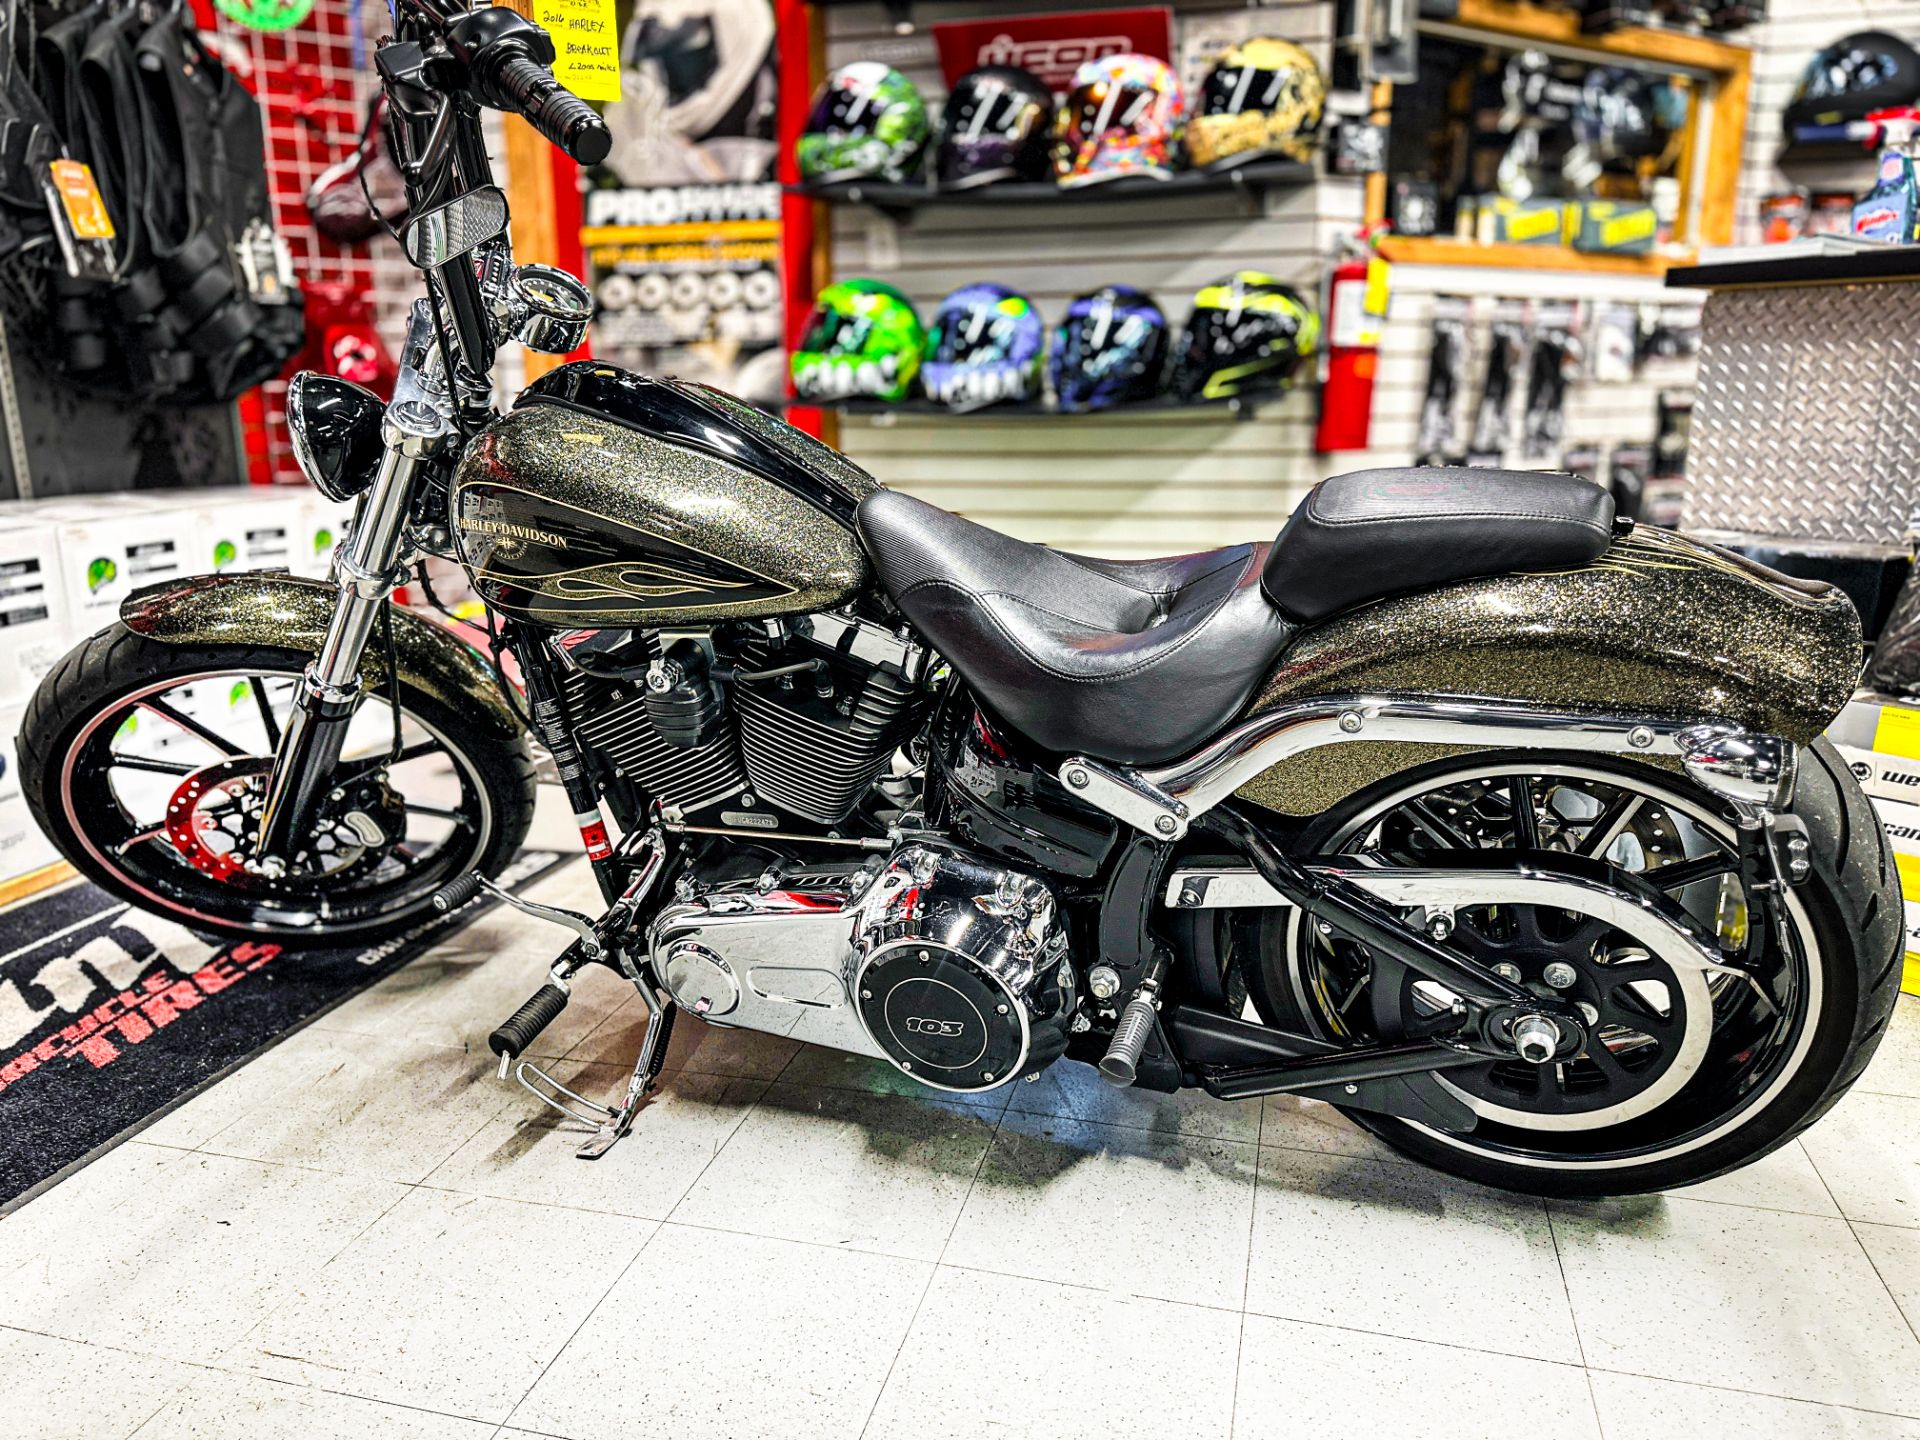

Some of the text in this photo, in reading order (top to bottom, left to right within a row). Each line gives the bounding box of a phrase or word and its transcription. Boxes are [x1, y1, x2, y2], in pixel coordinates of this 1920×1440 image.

[543, 10, 605, 33] 2016 HARLEY
[63, 941, 283, 1069] TIRES
[905, 1016, 964, 1037] 103
